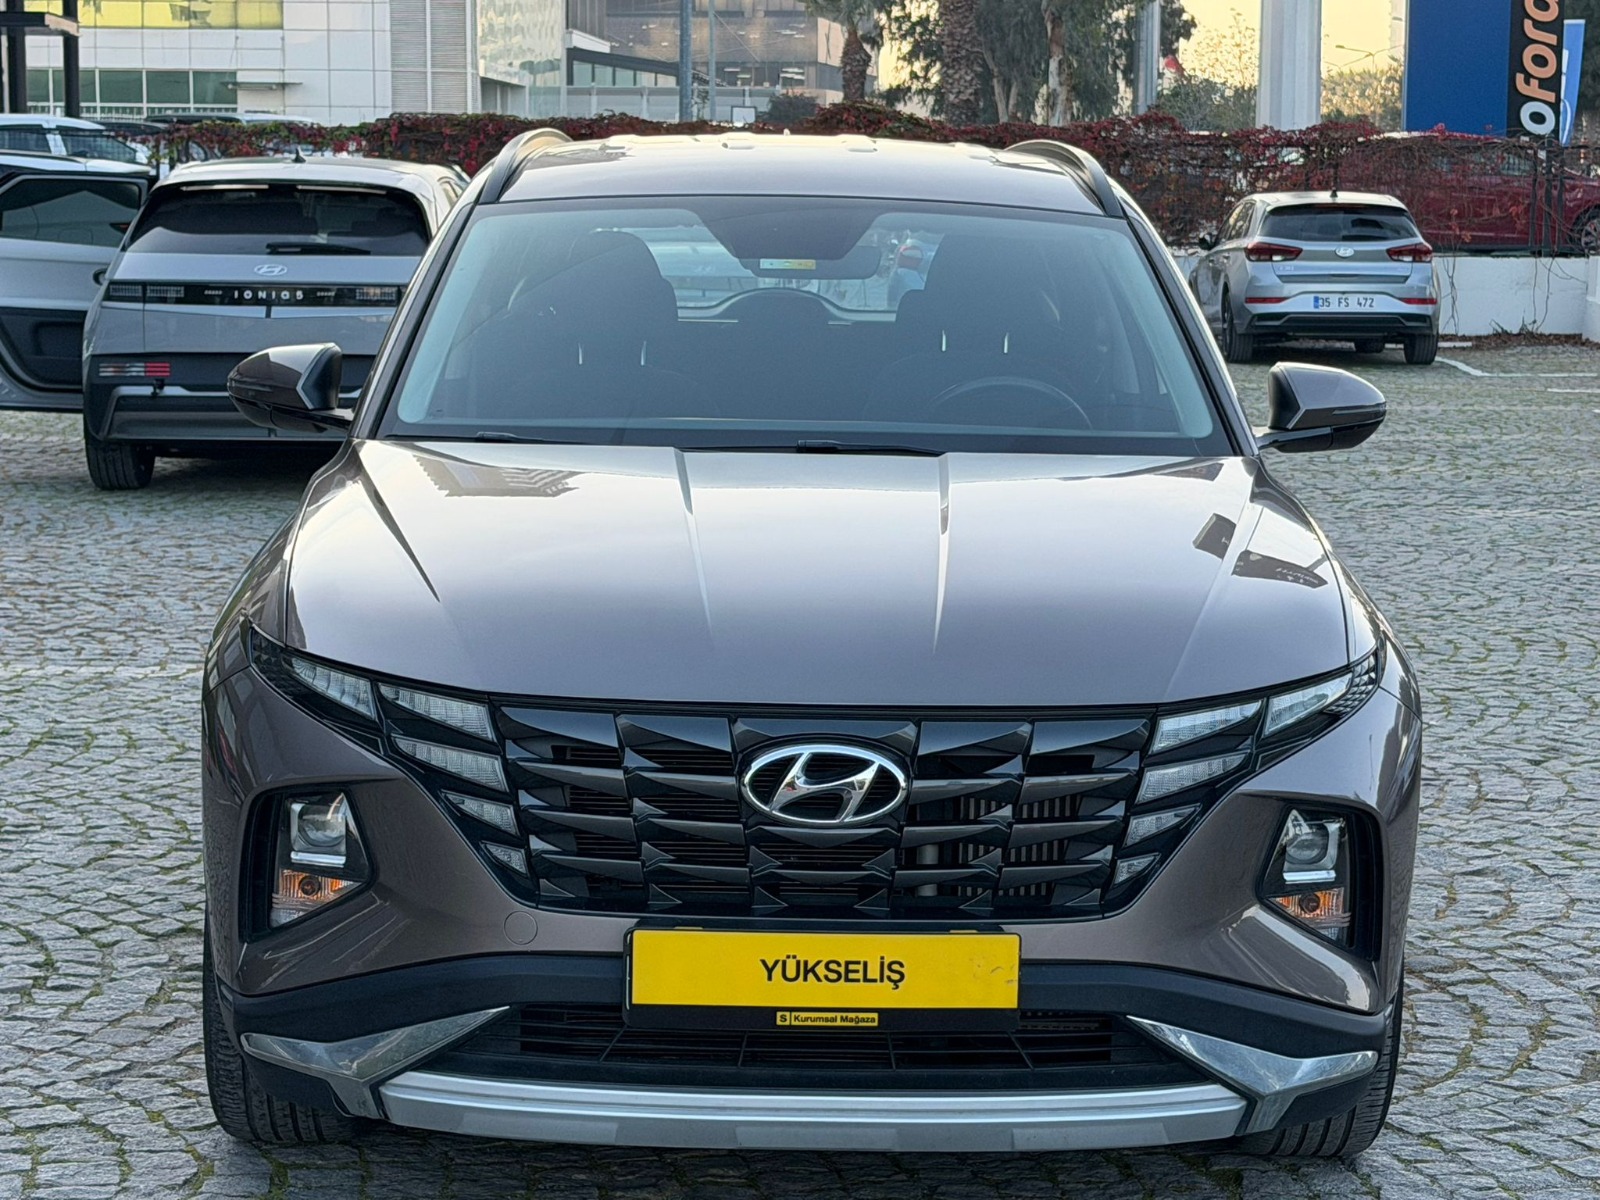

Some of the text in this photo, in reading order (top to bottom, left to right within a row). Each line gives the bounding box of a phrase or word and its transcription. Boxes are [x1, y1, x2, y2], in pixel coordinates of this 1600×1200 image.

[1320, 297, 1375, 308] 35 FS 472
[759, 954, 905, 991] YÜKSELİŞ
[779, 1014, 876, 1025] S Kurumsal Mağaza
